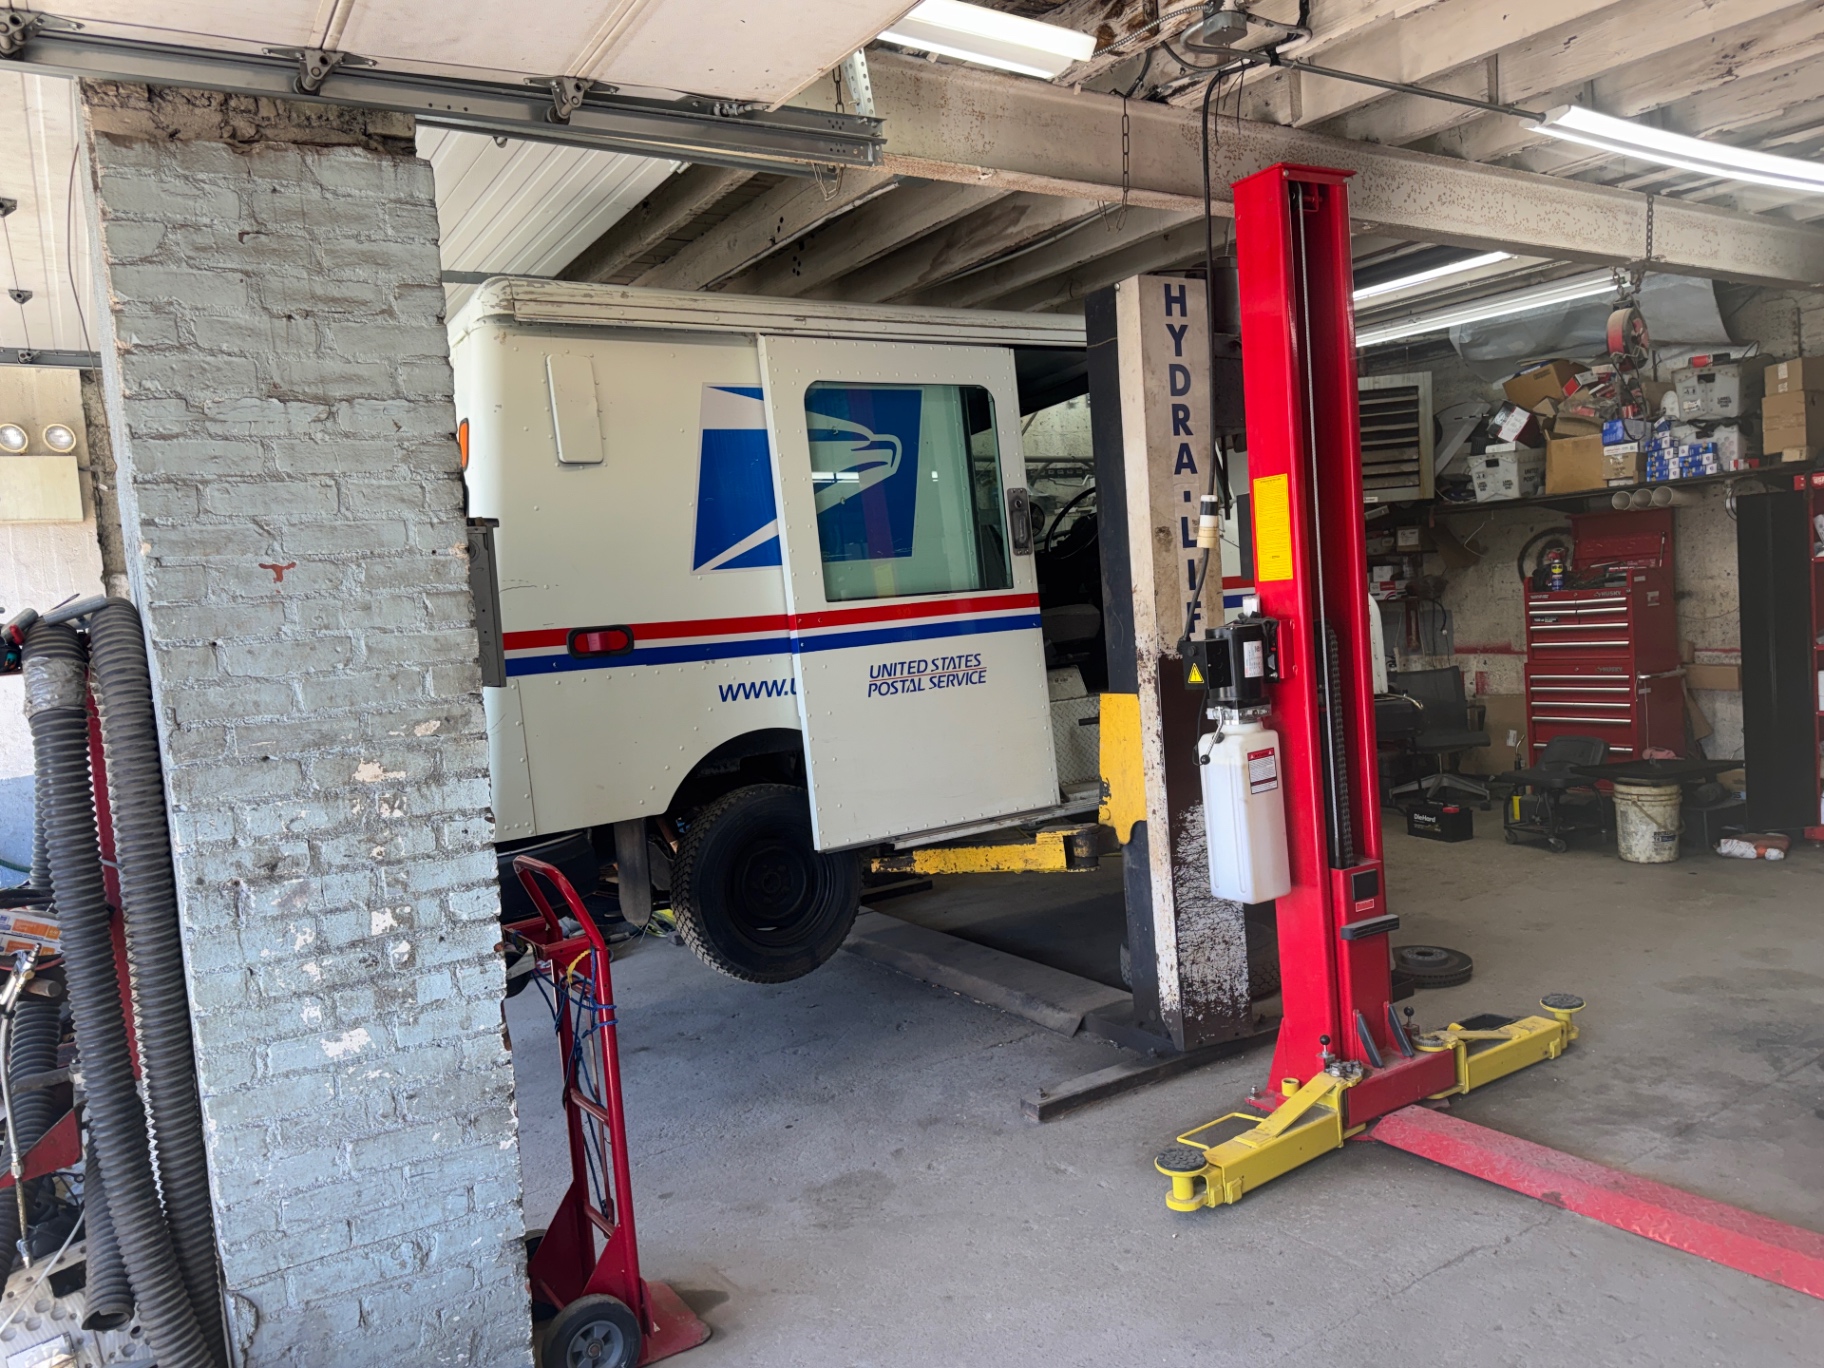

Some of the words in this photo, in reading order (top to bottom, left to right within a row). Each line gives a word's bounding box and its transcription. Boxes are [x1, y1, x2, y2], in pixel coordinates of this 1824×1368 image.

[869, 659, 928, 679] UNITED
[930, 653, 982, 672] STATES
[867, 677, 926, 698] POSTAL
[928, 669, 987, 690] SERVICE
[1413, 813, 1437, 823] DieHard
